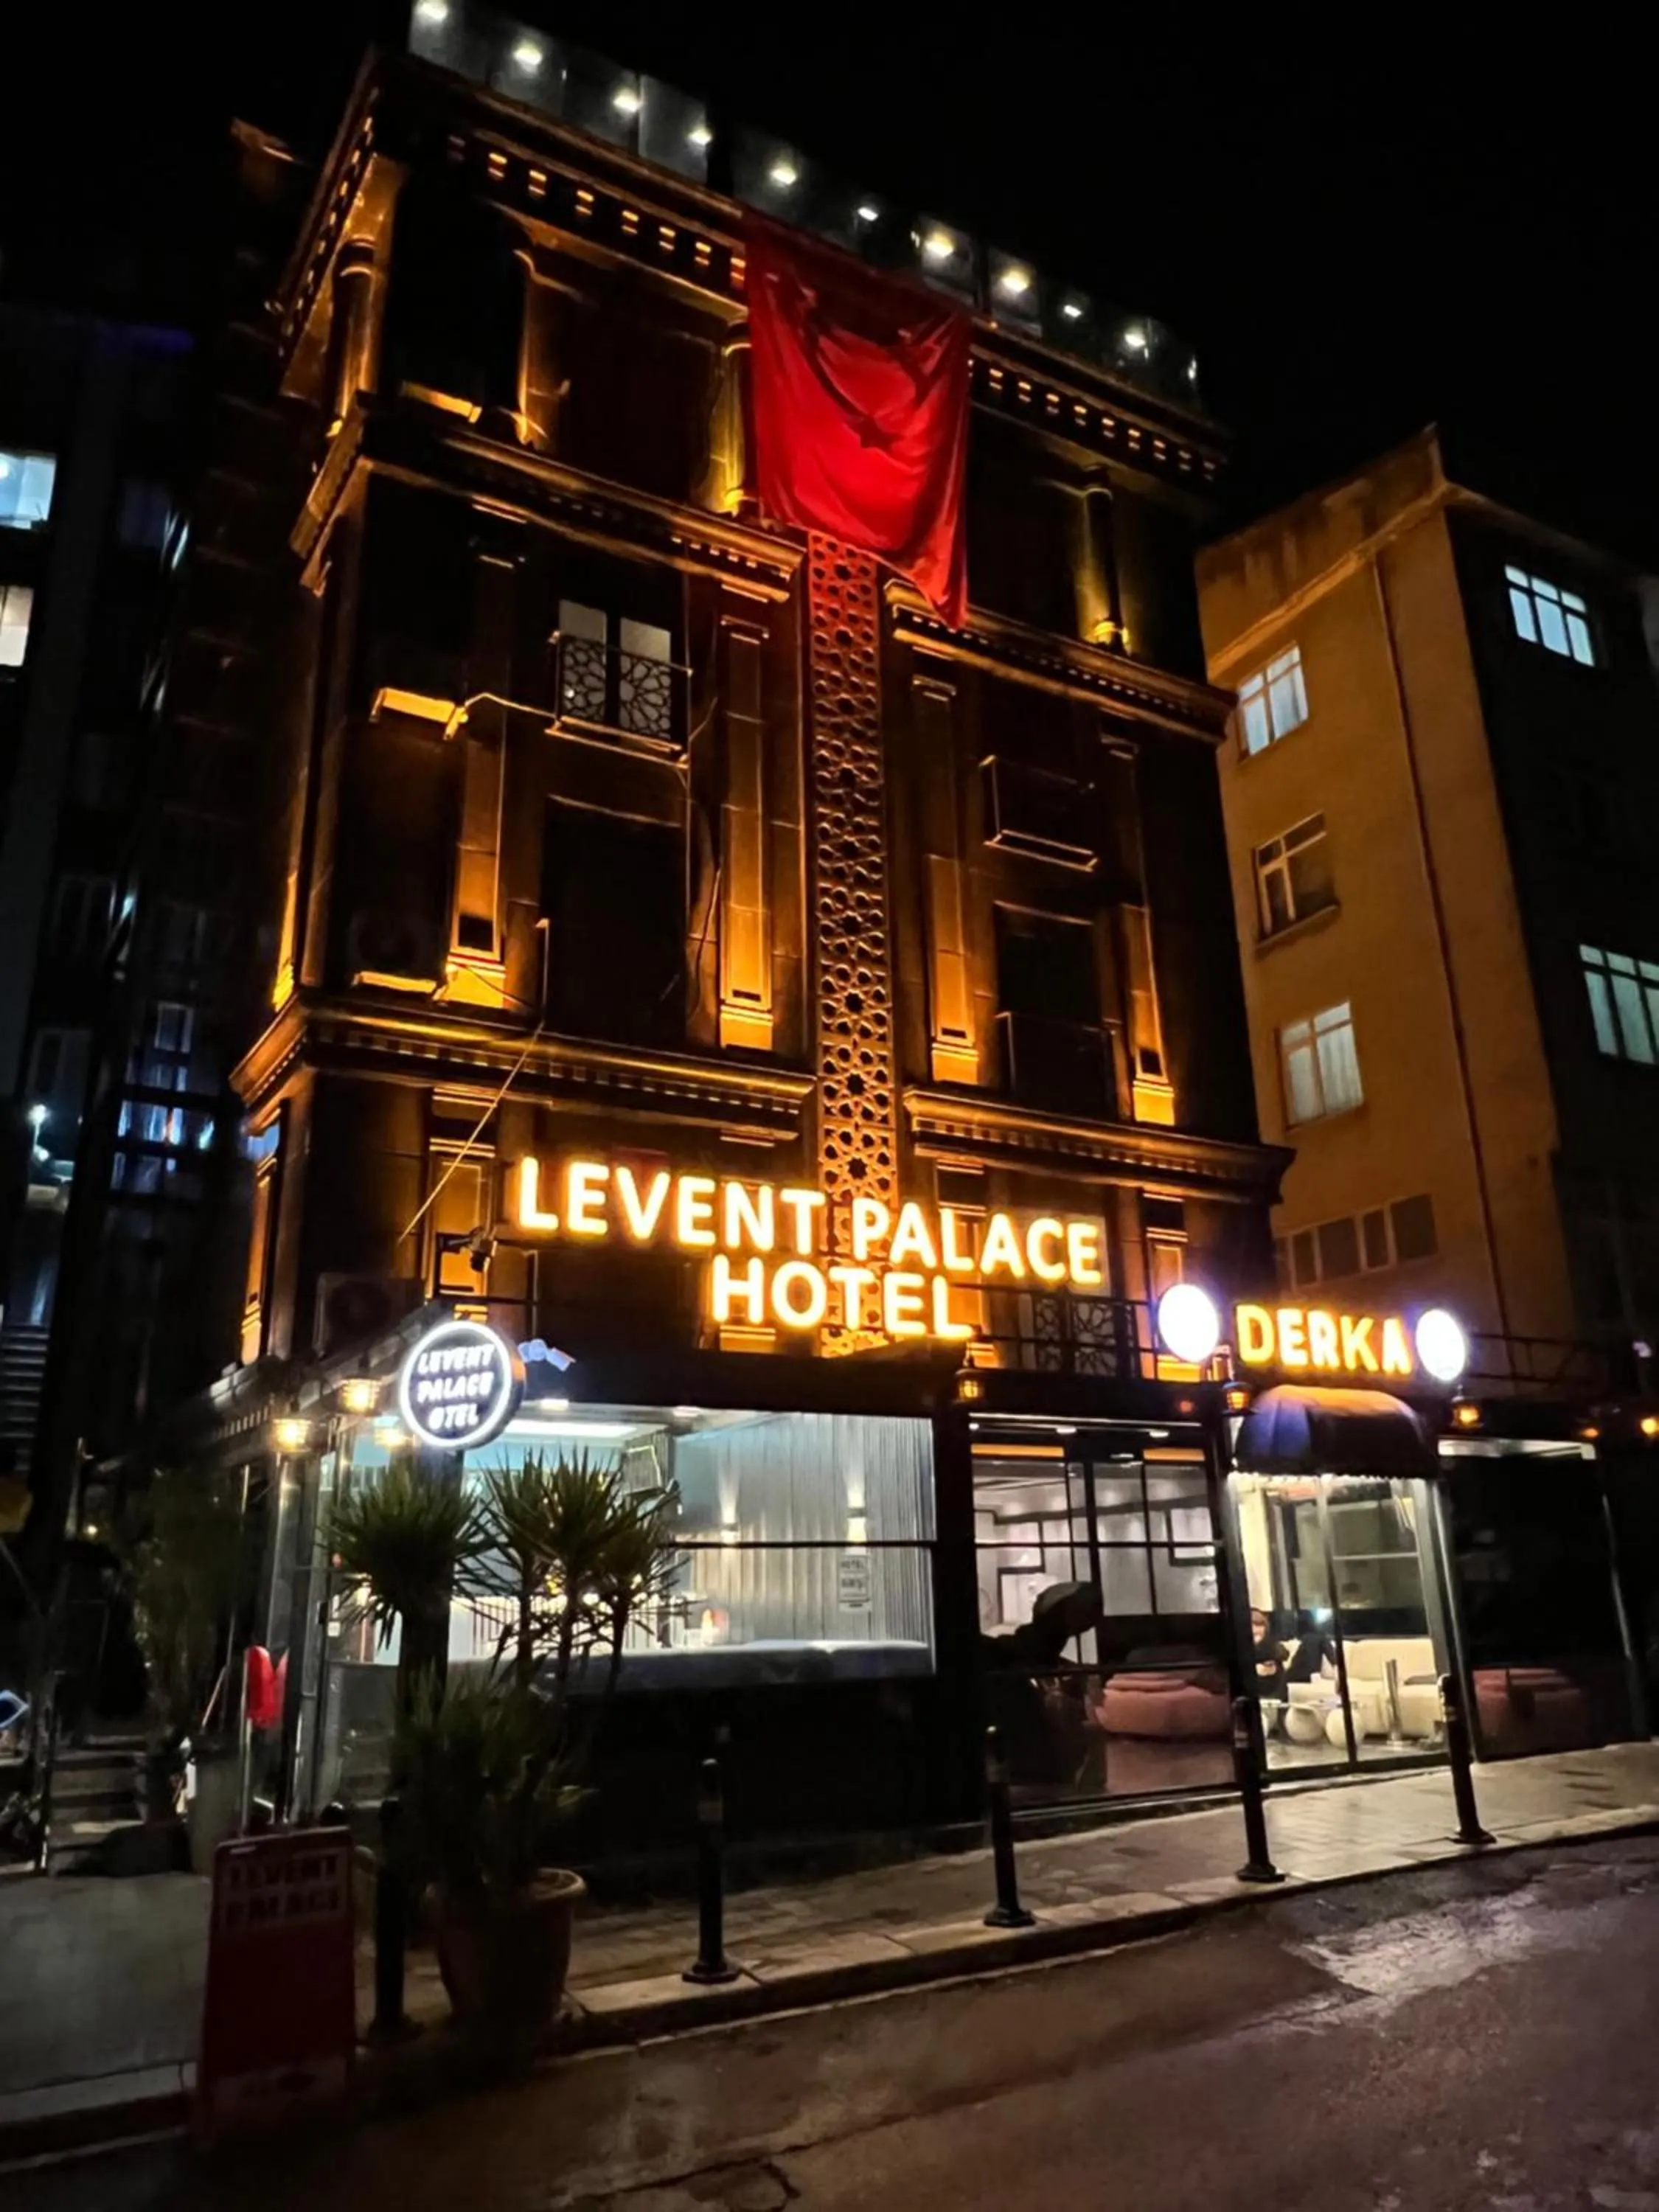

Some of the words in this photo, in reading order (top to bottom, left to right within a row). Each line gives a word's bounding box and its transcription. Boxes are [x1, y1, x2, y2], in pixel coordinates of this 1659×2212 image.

[518, 1155, 827, 1253] LEVENT
[852, 1196, 1103, 1285] PALACE
[712, 1253, 973, 1339] HOTEL
[417, 1343, 495, 1375] LEVENT
[1235, 1303, 1413, 1375] DERKA
[417, 1371, 495, 1403] PALACE
